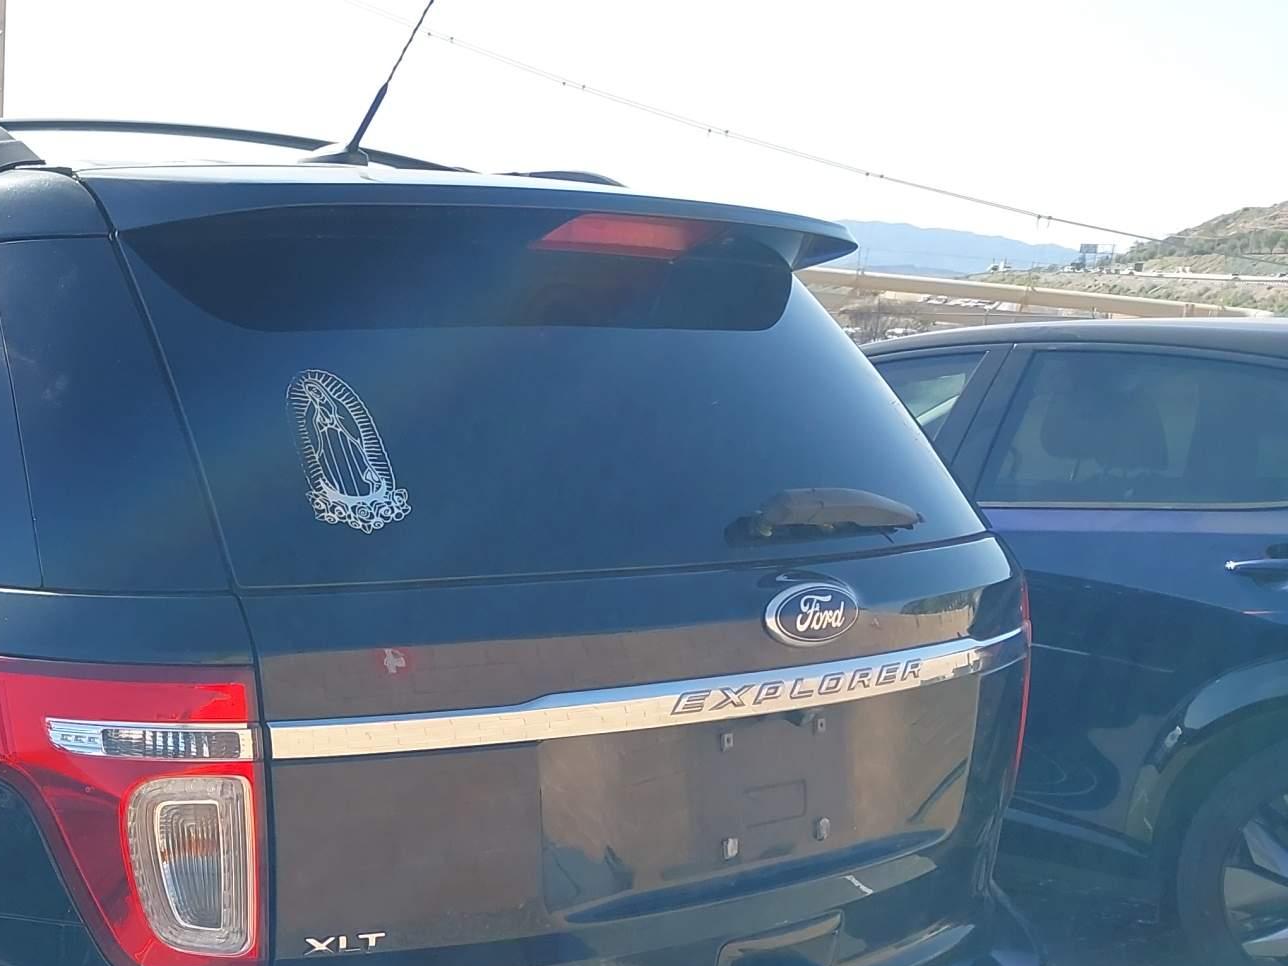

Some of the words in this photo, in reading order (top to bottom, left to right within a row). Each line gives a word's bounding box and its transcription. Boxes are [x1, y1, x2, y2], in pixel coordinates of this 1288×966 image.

[796, 594, 845, 633] Ford
[670, 658, 921, 716] EXPLORER
[304, 932, 386, 956] XLT
